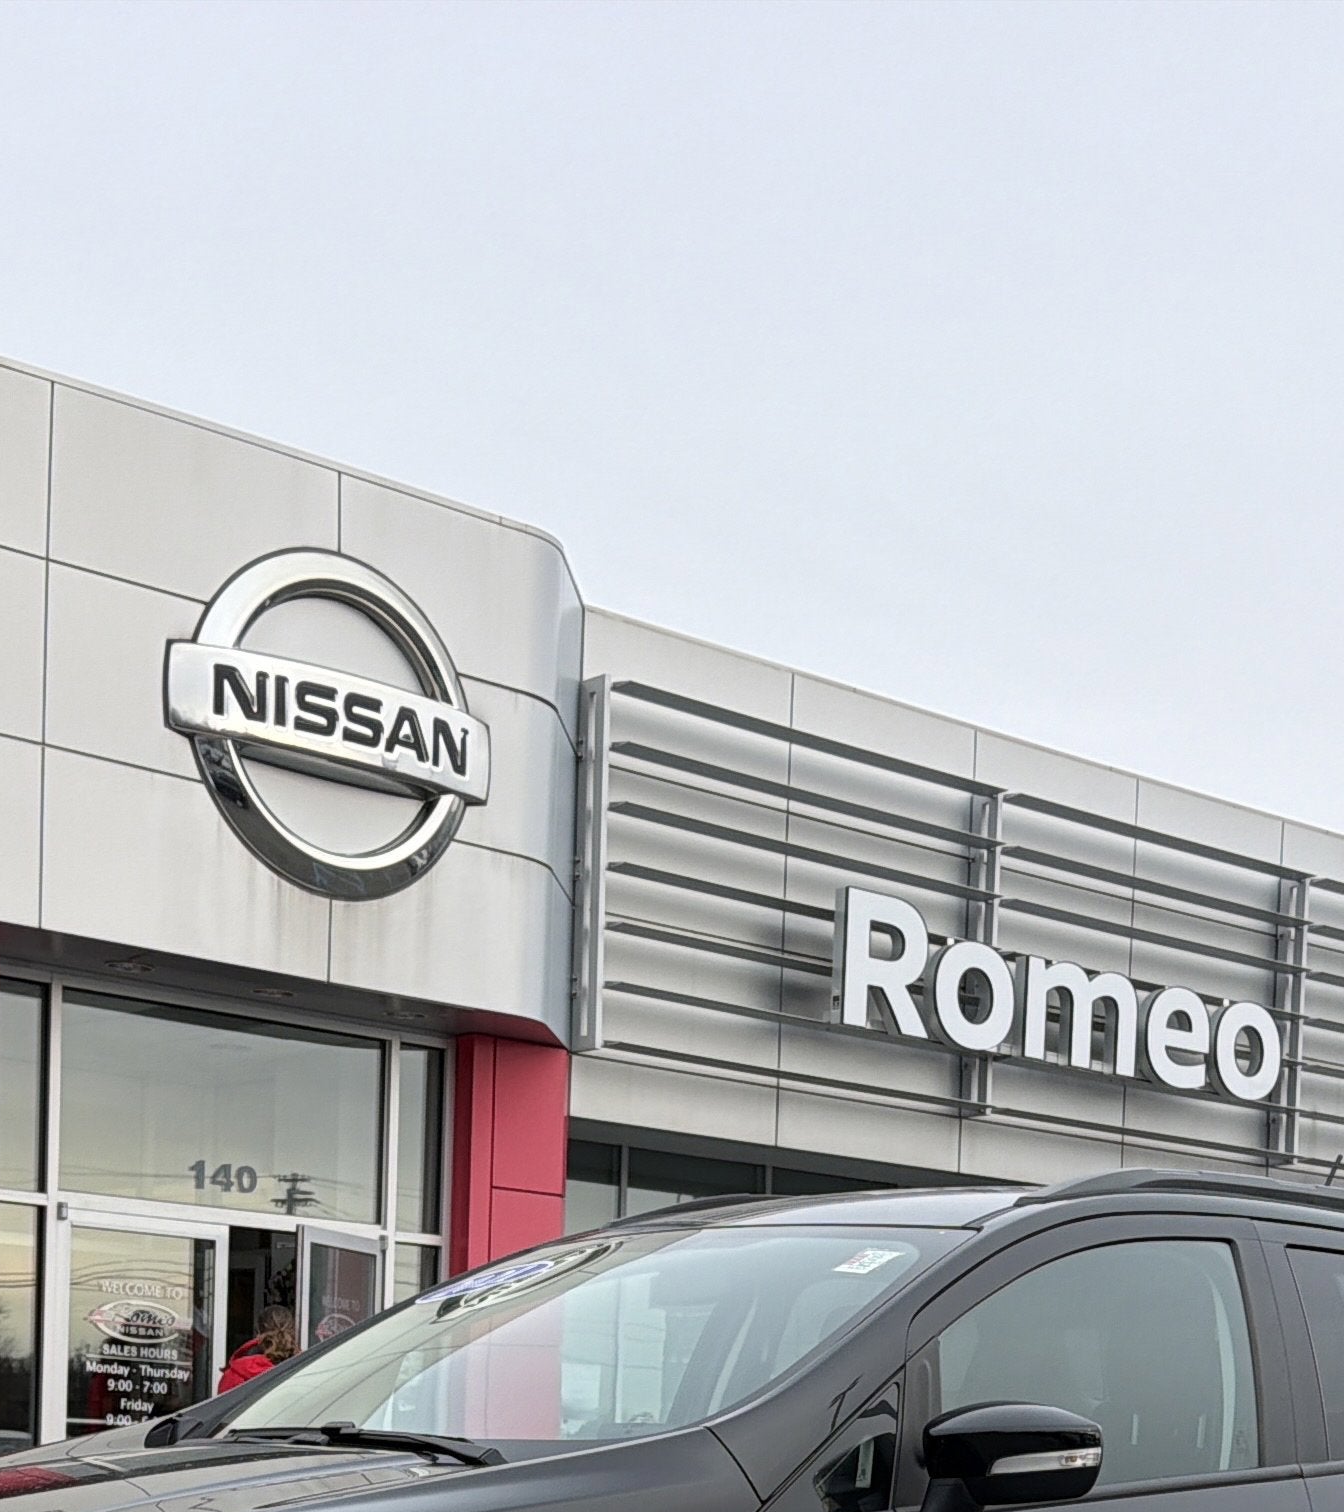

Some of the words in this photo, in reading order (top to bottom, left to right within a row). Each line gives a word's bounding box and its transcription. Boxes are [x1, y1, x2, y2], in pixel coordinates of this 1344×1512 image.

[212, 663, 469, 776] NISSAN
[835, 885, 1281, 1100] Romeo
[188, 1160, 257, 1193] 140
[102, 1281, 162, 1297] WELCOME
[166, 1286, 183, 1299] TO
[118, 1325, 164, 1336] NISSAN
[103, 1344, 137, 1357] SALES
[140, 1347, 178, 1360] HOURS
[86, 1360, 130, 1377] Monday
[140, 1365, 190, 1381] Thursday
[108, 1379, 133, 1392] 9:00
[143, 1381, 168, 1394] 7:00
[120, 1398, 155, 1414] Friday
[106, 1413, 132, 1426] 9:00
